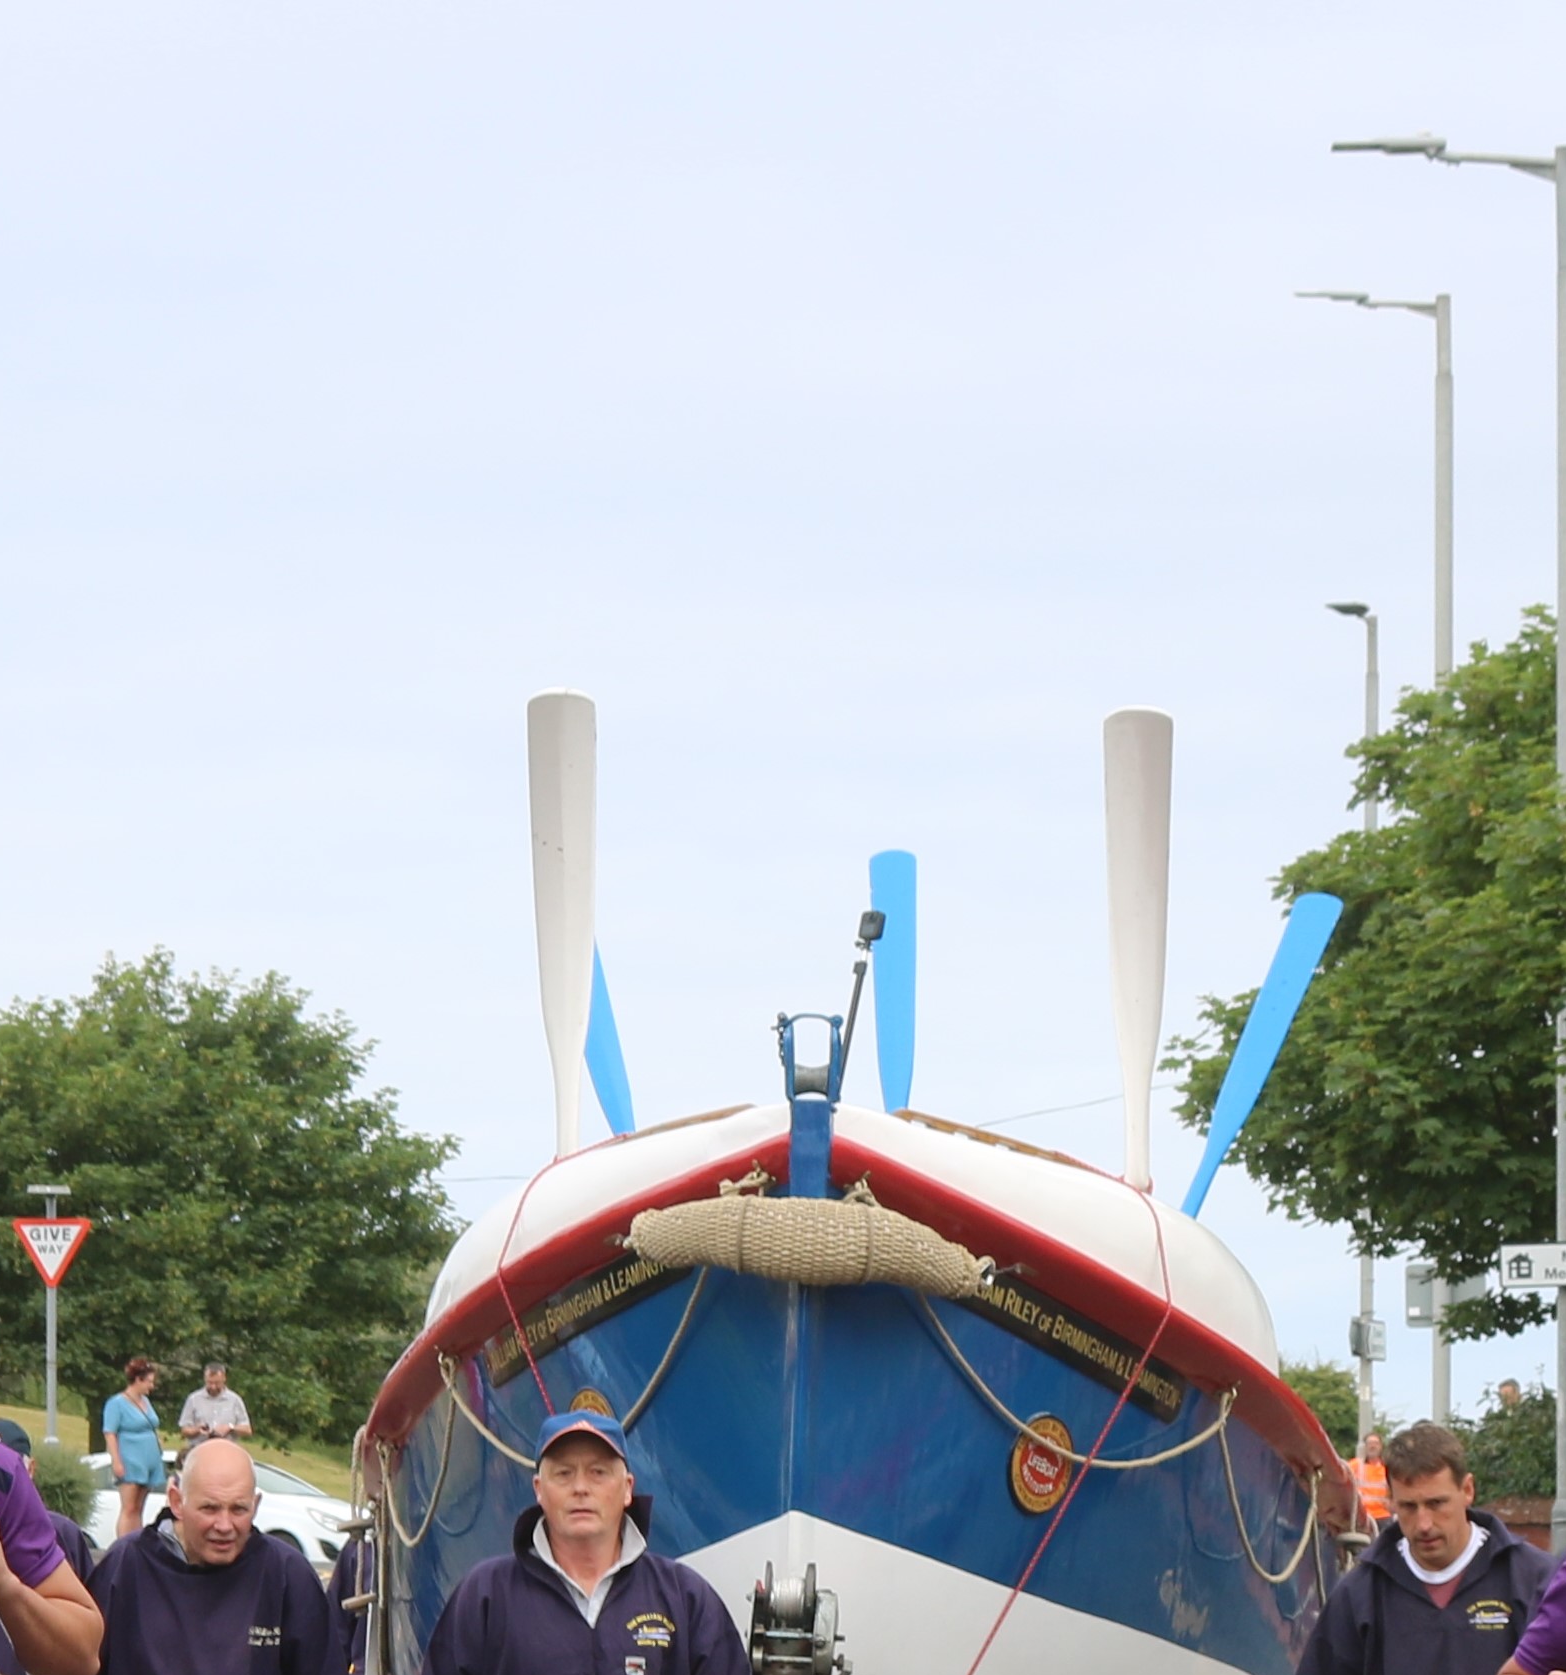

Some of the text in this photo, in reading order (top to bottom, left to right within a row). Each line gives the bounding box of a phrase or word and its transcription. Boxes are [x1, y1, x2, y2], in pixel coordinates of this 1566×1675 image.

[29, 1227, 72, 1242] GIVE
[37, 1245, 64, 1255] WAY
[545, 1282, 604, 1334] BIRMINGHAM
[601, 1279, 612, 1301] &
[1004, 1288, 1041, 1325] RILEY
[1052, 1314, 1119, 1373] BIRMINGHAM
[1116, 1354, 1125, 1377] &
